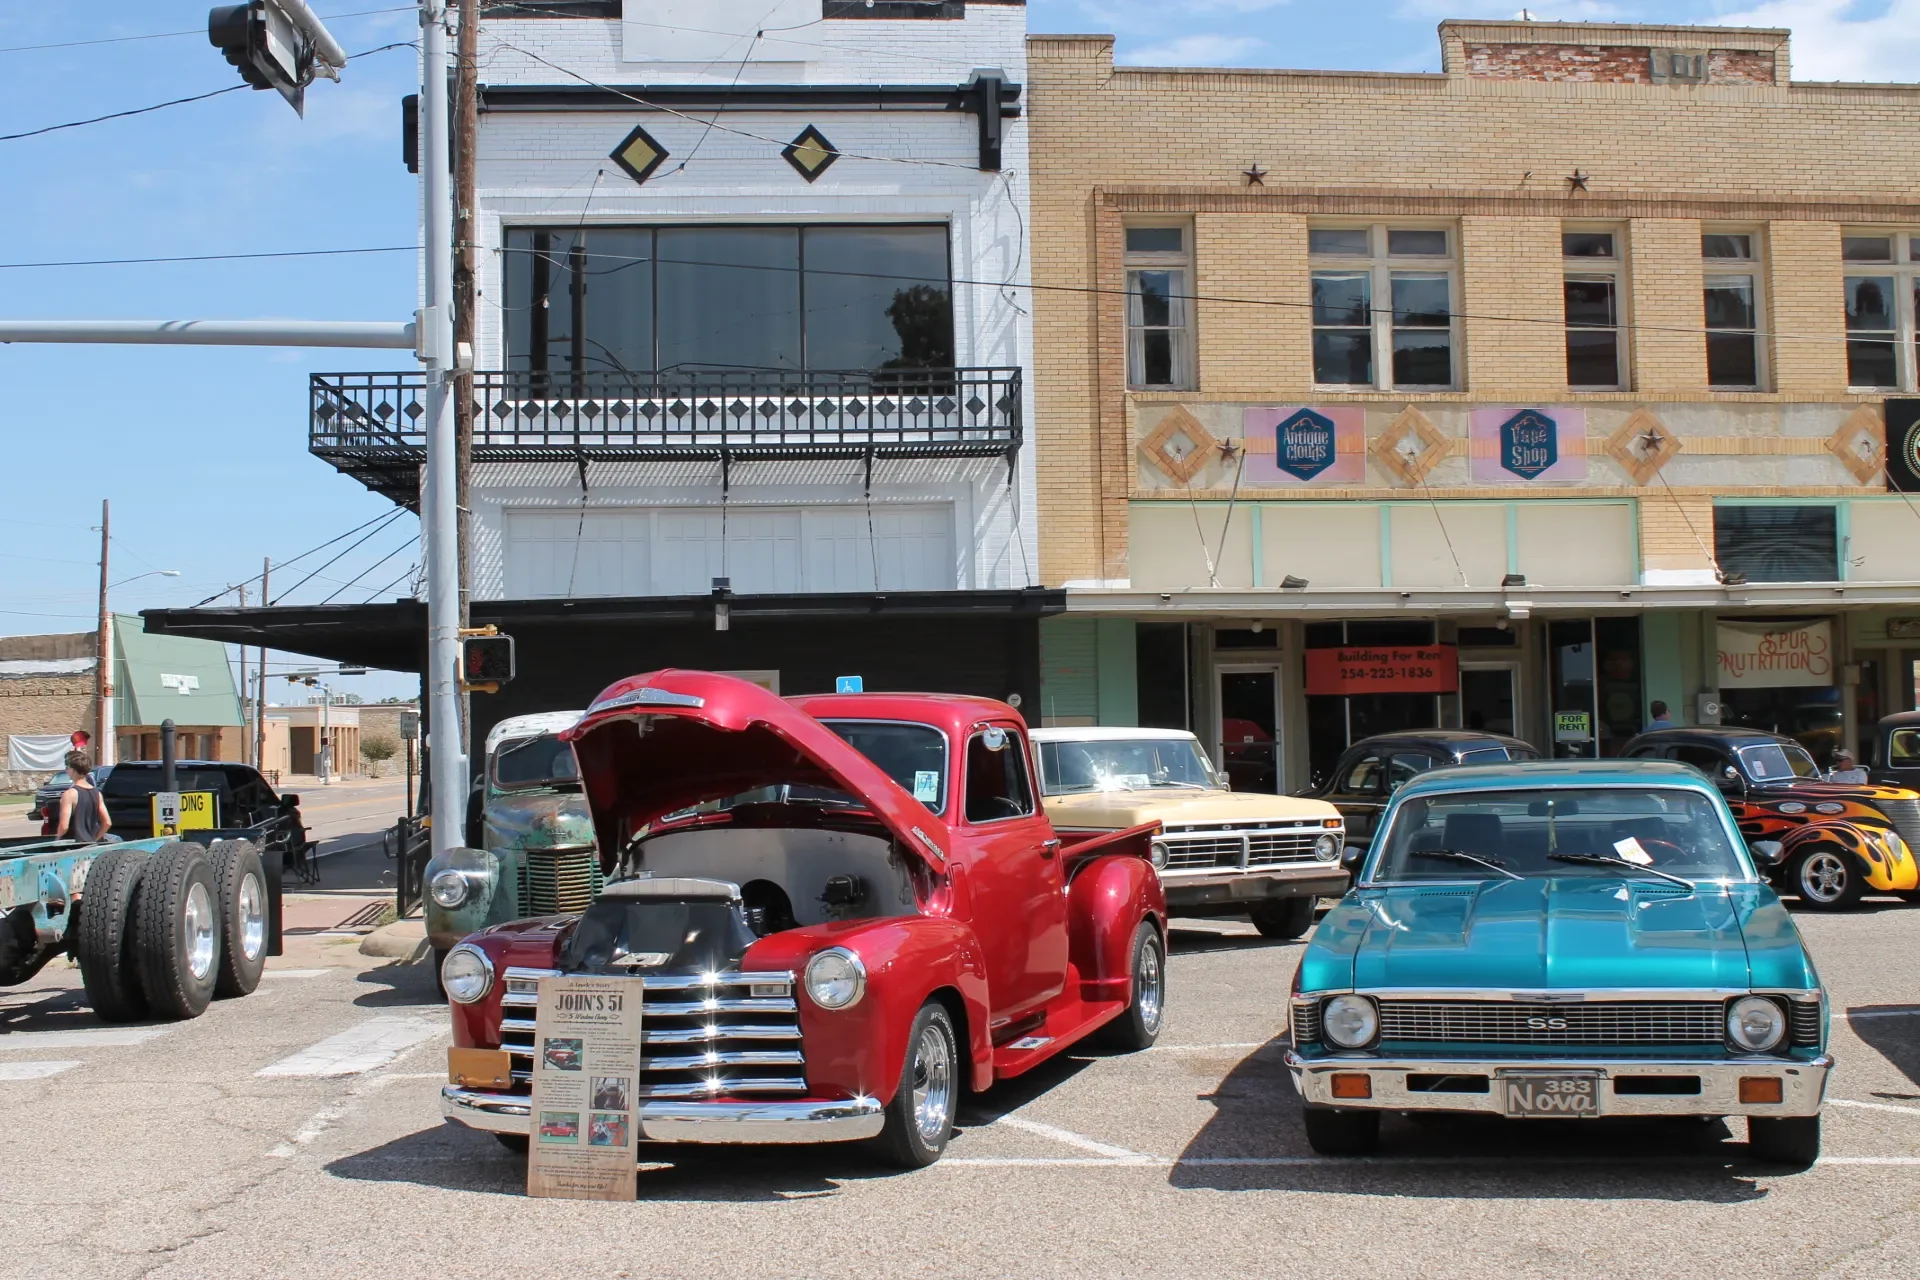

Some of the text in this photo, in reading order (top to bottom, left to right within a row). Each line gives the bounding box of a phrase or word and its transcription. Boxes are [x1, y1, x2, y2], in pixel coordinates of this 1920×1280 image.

[1283, 427, 1329, 448] Antique
[1510, 427, 1548, 447] Vape
[1511, 445, 1548, 467] Shop
[1337, 651, 1389, 664] Building
[1393, 651, 1413, 662] For
[1717, 650, 1830, 678] NUTRITION
[1340, 667, 1433, 680] 254-223-1836
[1561, 715, 1583, 723] FOR
[1558, 723, 1587, 731] RENT
[180, 794, 204, 812] DING
[1185, 821, 1304, 833] FORD
[555, 994, 623, 1012] JOHN'S 51
[1527, 1017, 1568, 1030] SS
[1545, 1080, 1591, 1093] 383
[1508, 1083, 1597, 1112] Nova
